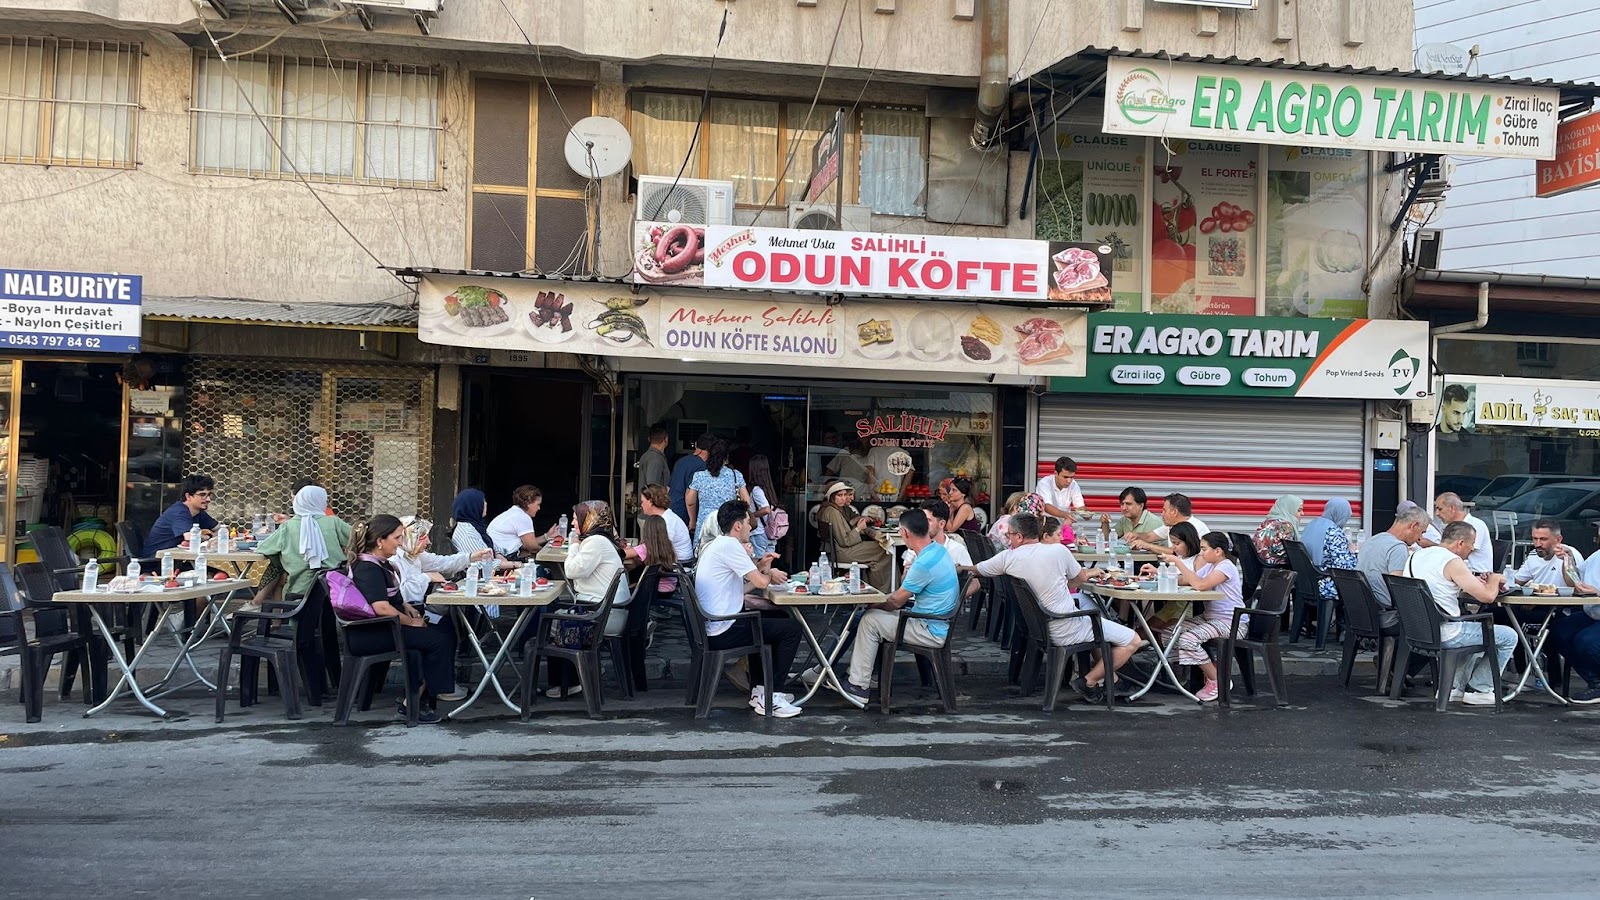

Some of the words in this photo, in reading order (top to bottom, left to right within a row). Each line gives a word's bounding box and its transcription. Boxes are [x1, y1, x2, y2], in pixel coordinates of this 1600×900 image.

[1150, 95, 1186, 107] ErAgro
[1504, 96, 1530, 111] Zirai
[1532, 95, 1553, 117] İlaç
[1190, 75, 1242, 129] ER
[1246, 79, 1362, 138] AGRO
[1373, 87, 1491, 144] TARIM
[1503, 113, 1538, 130] Gübre
[1073, 135, 1128, 146] CLAUSE
[1502, 131, 1540, 147] Tohum
[1556, 136, 1591, 154] RÜNLERİ
[1188, 142, 1241, 152] CLAUSE
[1301, 147, 1352, 156] CLAUSE
[1201, 168, 1213, 177] EL
[1216, 168, 1248, 178] FORTE
[768, 236, 807, 250] Mehmet
[811, 236, 835, 250] Usta
[851, 235, 926, 254] SALİHLİ
[732, 251, 871, 287] ODUN
[888, 251, 1039, 293] KÖFTE
[54, 305, 113, 317] Hırdavat
[668, 308, 752, 326] Meşhur
[762, 306, 836, 326] Salihli
[15, 317, 61, 329] Naylon
[65, 319, 122, 332] Çeşitleri
[9, 335, 38, 345] 0543
[42, 336, 64, 346] 797
[67, 337, 82, 347] 84
[86, 338, 100, 348] 62
[666, 329, 716, 348] ODUN
[721, 328, 768, 351] KÖFTE
[773, 335, 837, 354] SALONU
[1093, 325, 1133, 354] ER
[1135, 326, 1223, 357] AGRO
[1227, 328, 1319, 358] TARIM
[1116, 369, 1141, 381] Zirai
[1189, 369, 1221, 382] Gübre
[1253, 372, 1287, 383] Tohum
[1479, 398, 1528, 422] ADİL
[1551, 407, 1579, 424] SAÇ
[856, 410, 950, 442] SALİHLİ
[870, 437, 900, 447] ODUN
[902, 437, 935, 448] KÖFTE
